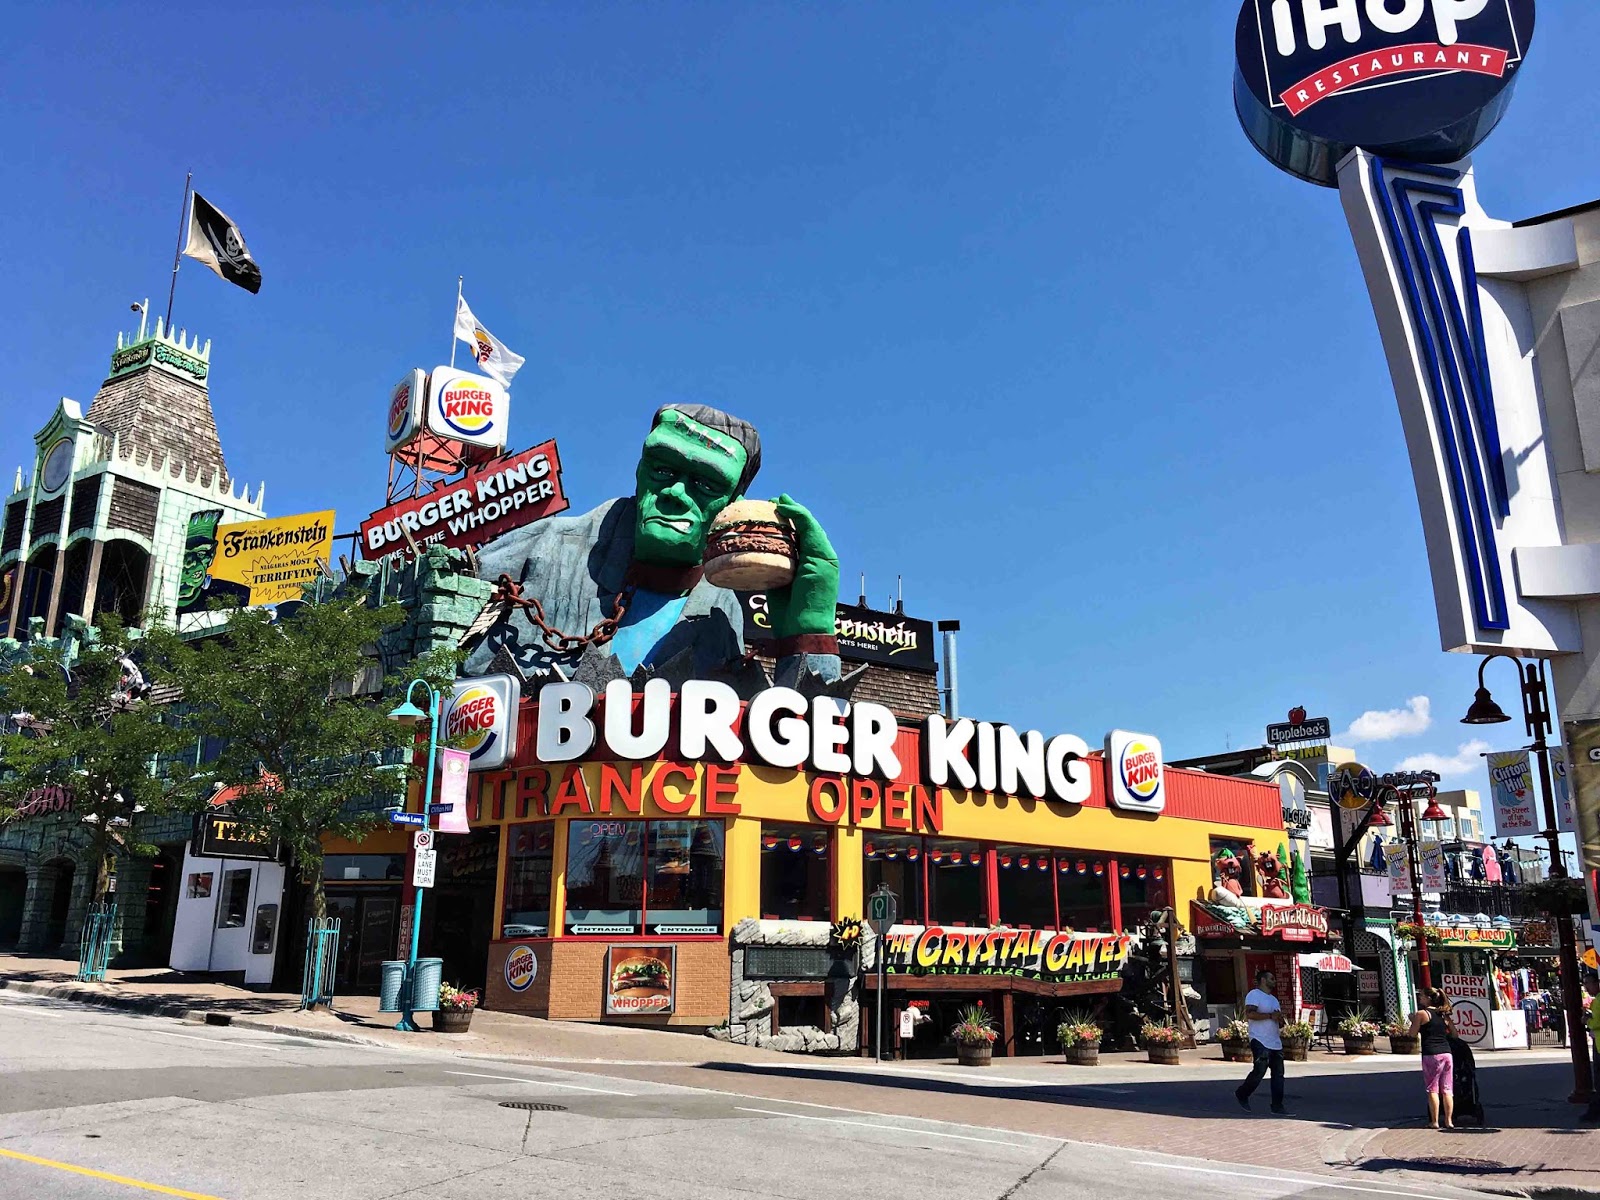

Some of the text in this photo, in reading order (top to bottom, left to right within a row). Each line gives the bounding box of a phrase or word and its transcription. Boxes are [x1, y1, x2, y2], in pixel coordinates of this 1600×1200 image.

[1296, 51, 1491, 103] RESTAURANT
[445, 390, 492, 403] BURGER
[446, 401, 493, 418] KING
[367, 453, 552, 550] BURGER KING
[423, 530, 446, 546] THE
[448, 481, 554, 537] WHOPPER
[223, 519, 327, 558] Frankenstein
[253, 567, 319, 584] TERRIFYING
[857, 642, 878, 651] HERE!
[449, 697, 495, 724] BURGER
[449, 708, 495, 738] KING
[1271, 722, 1326, 742] Applebee's
[536, 679, 1092, 803] BURGER KING
[1125, 751, 1156, 772] BURGER
[1300, 746, 1325, 759] INN
[1127, 762, 1159, 789] KING
[1492, 762, 1527, 782] Clifton
[1504, 776, 1526, 793] Hill
[811, 777, 943, 832] OPEN
[590, 823, 625, 836] OPEN
[417, 876, 431, 884] TURN
[1438, 928, 1465, 941] urry
[917, 927, 1044, 967] CRYSTAL
[1046, 933, 1131, 972] CAVES
[508, 954, 533, 970] BURGER
[509, 961, 533, 980] KING
[886, 966, 896, 974] A
[979, 967, 1024, 976] MAZE
[1443, 975, 1485, 987] CURRY
[1445, 986, 1486, 998] QUEEN
[612, 997, 669, 1009] WHOPPER
